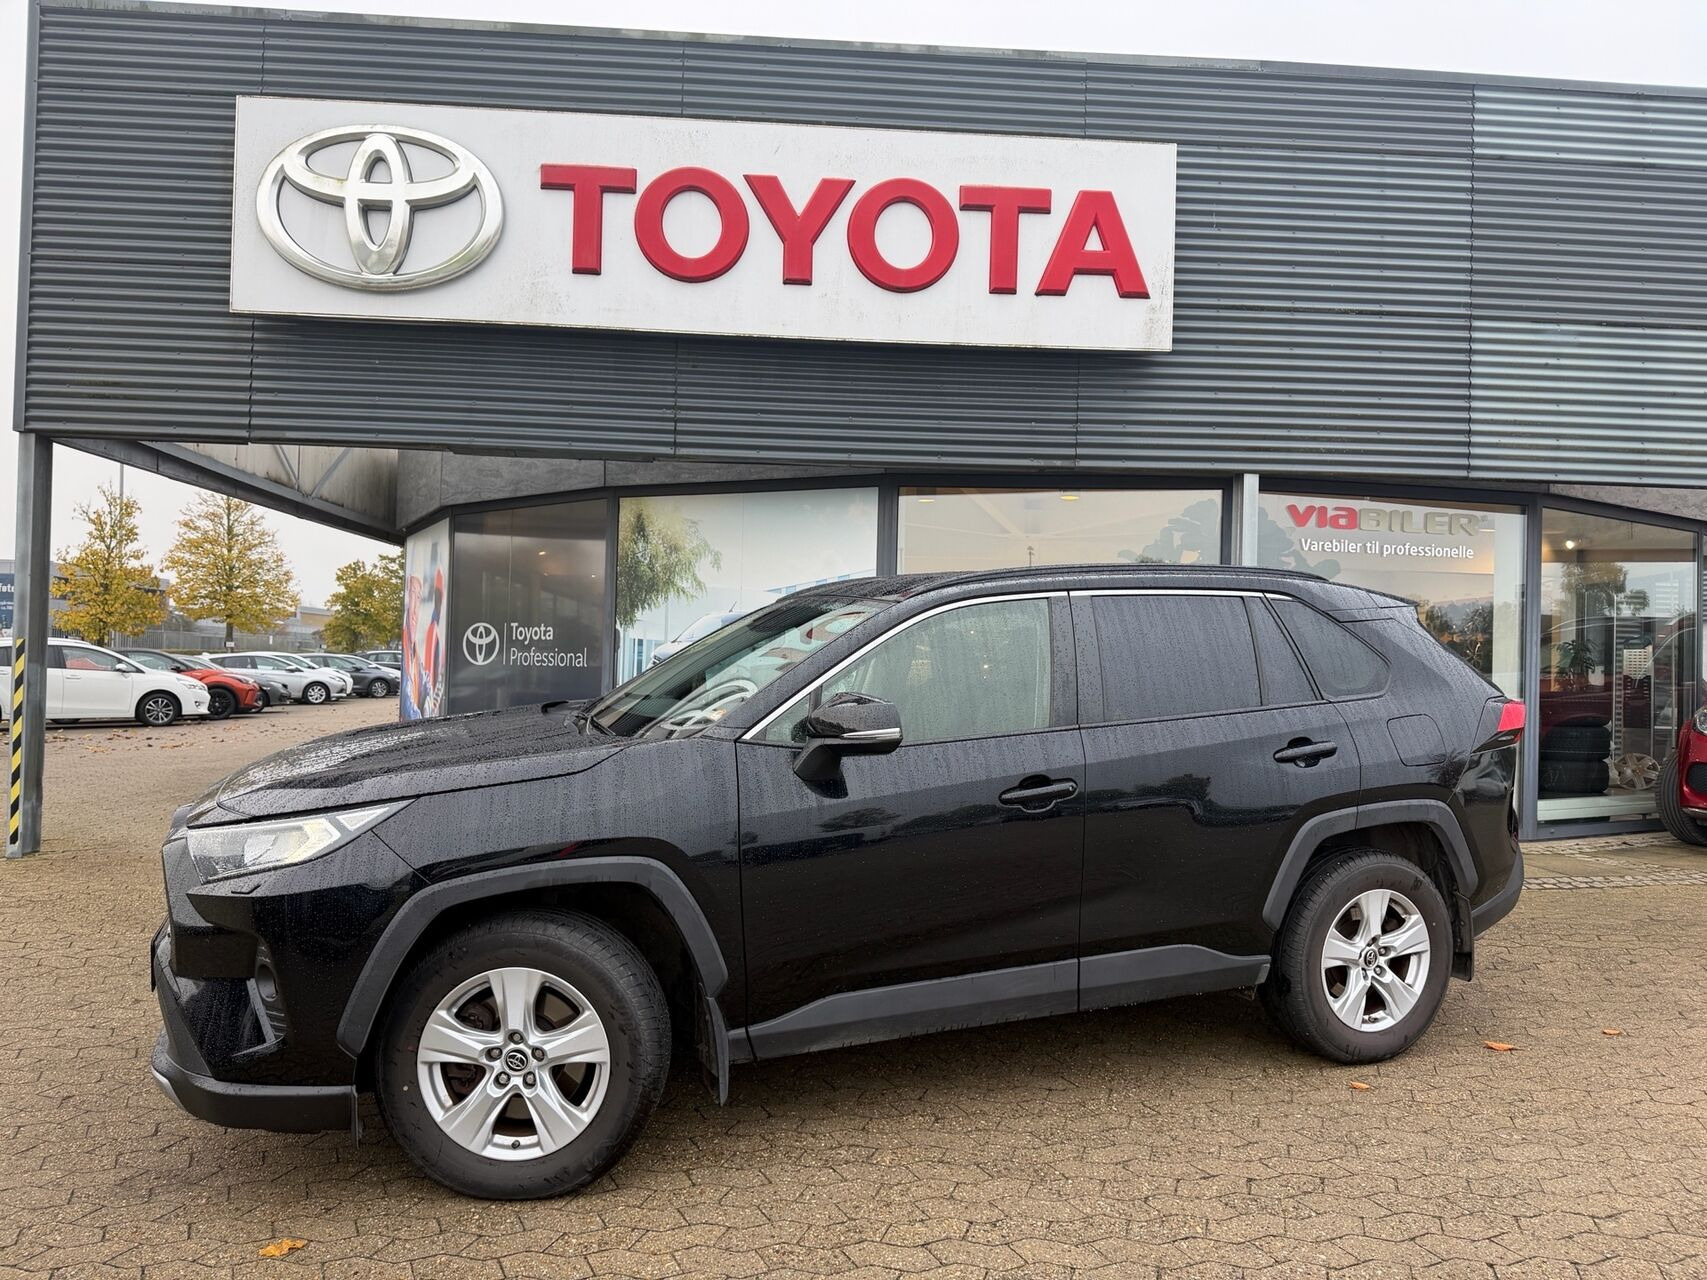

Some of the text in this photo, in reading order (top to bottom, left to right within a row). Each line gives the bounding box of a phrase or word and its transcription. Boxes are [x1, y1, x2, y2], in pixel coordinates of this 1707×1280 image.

[540, 164, 1151, 299] TOYOTA
[1301, 538, 1474, 559] Varebiler til professionelle
[510, 622, 554, 645] Toyota
[510, 647, 588, 667] Professional
